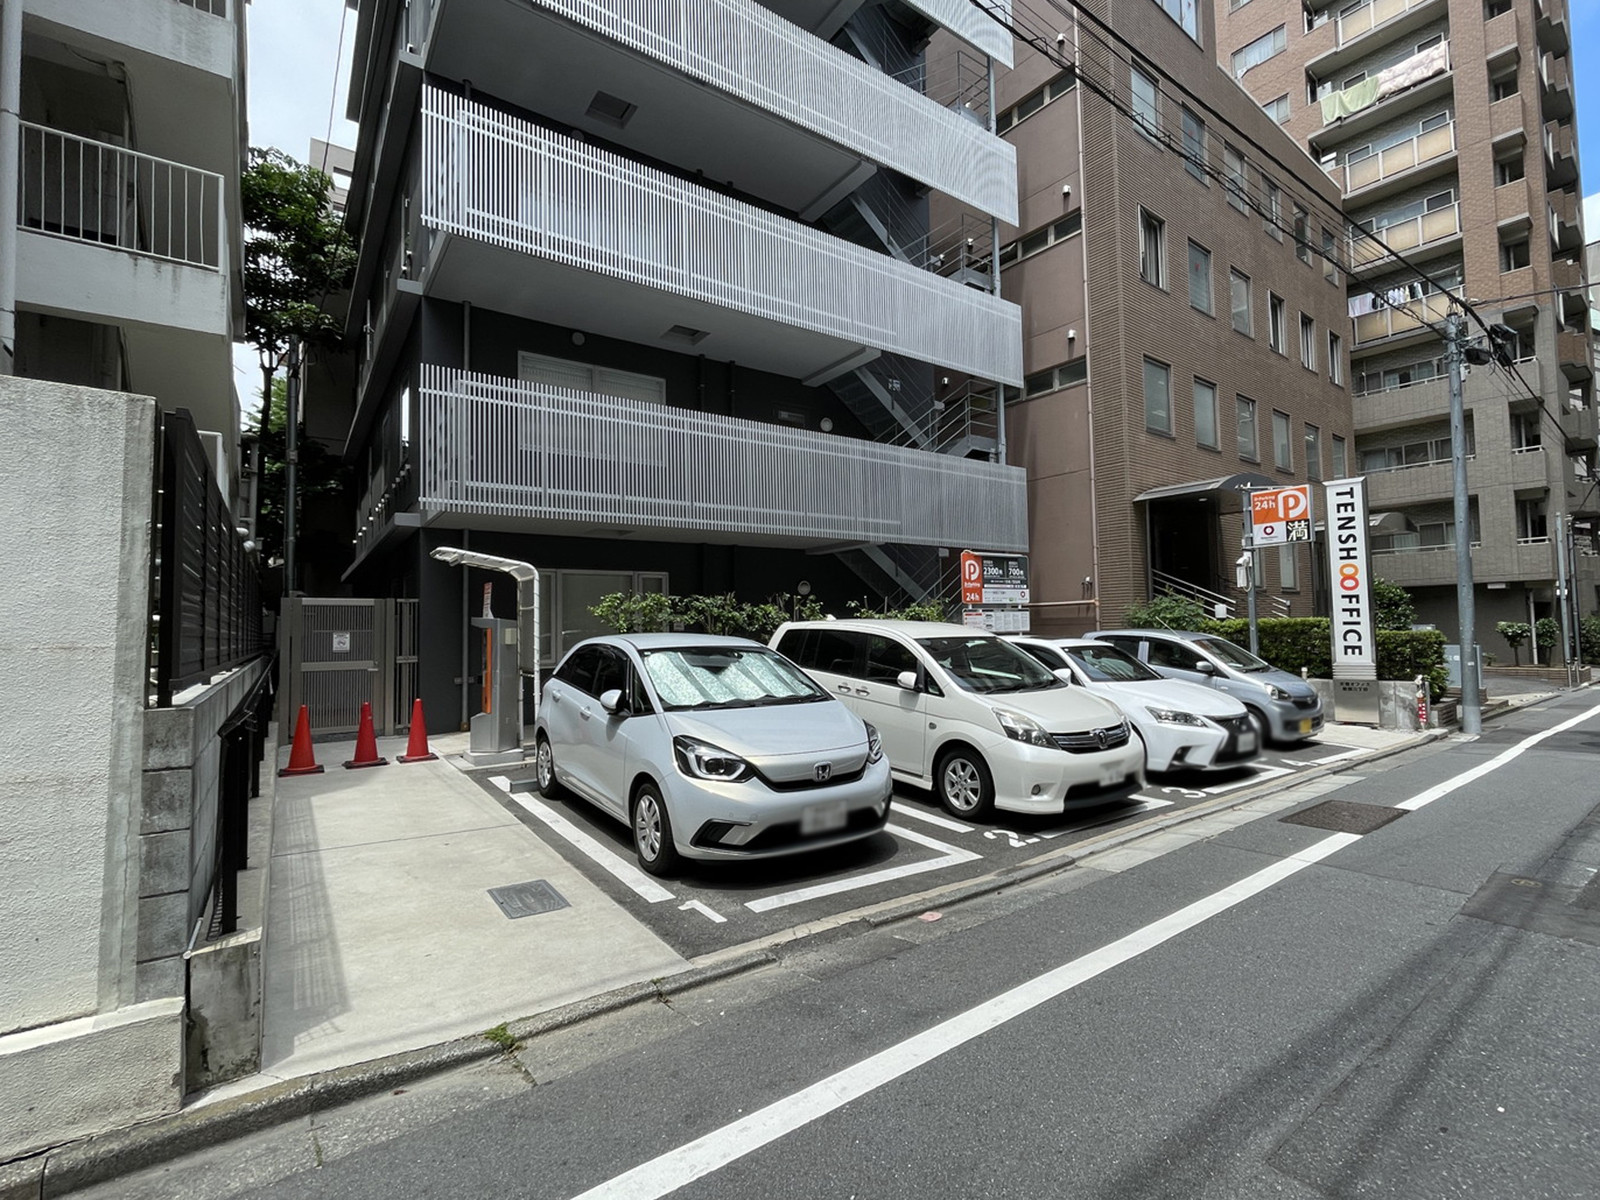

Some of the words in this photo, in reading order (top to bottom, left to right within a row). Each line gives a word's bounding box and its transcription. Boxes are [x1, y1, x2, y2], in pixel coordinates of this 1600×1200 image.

[1255, 500, 1275, 511] 24h
[1287, 520, 1309, 541] 満
[966, 593, 979, 601] 24h
[1161, 786, 1206, 798] 3
[678, 899, 728, 923] 1
